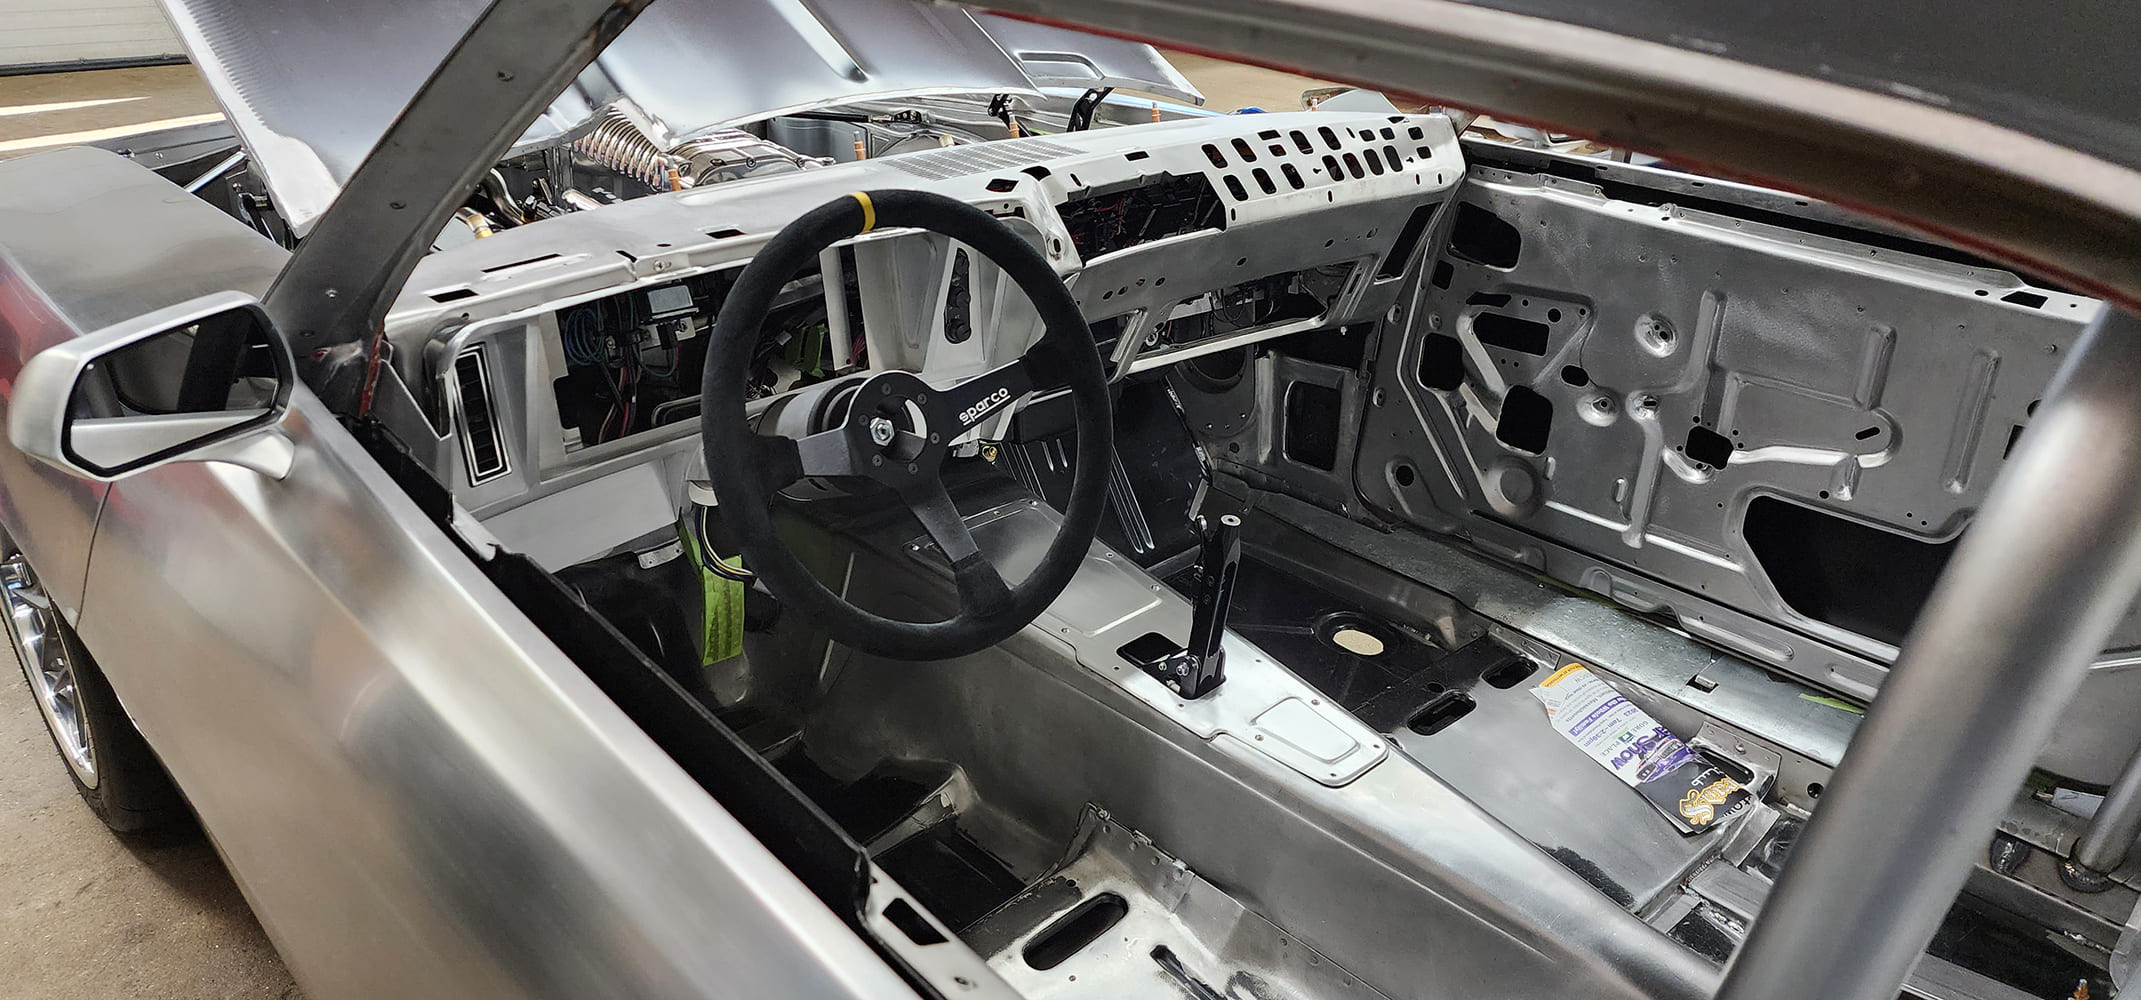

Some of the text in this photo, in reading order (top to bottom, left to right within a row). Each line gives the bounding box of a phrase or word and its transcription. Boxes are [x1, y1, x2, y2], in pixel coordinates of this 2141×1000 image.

[958, 387, 1009, 423] sparco
[1590, 704, 1609, 718] Whole
[1632, 720, 1649, 734] GORE
[1601, 740, 1621, 757] PLACE
[1610, 735, 1657, 771] Show
